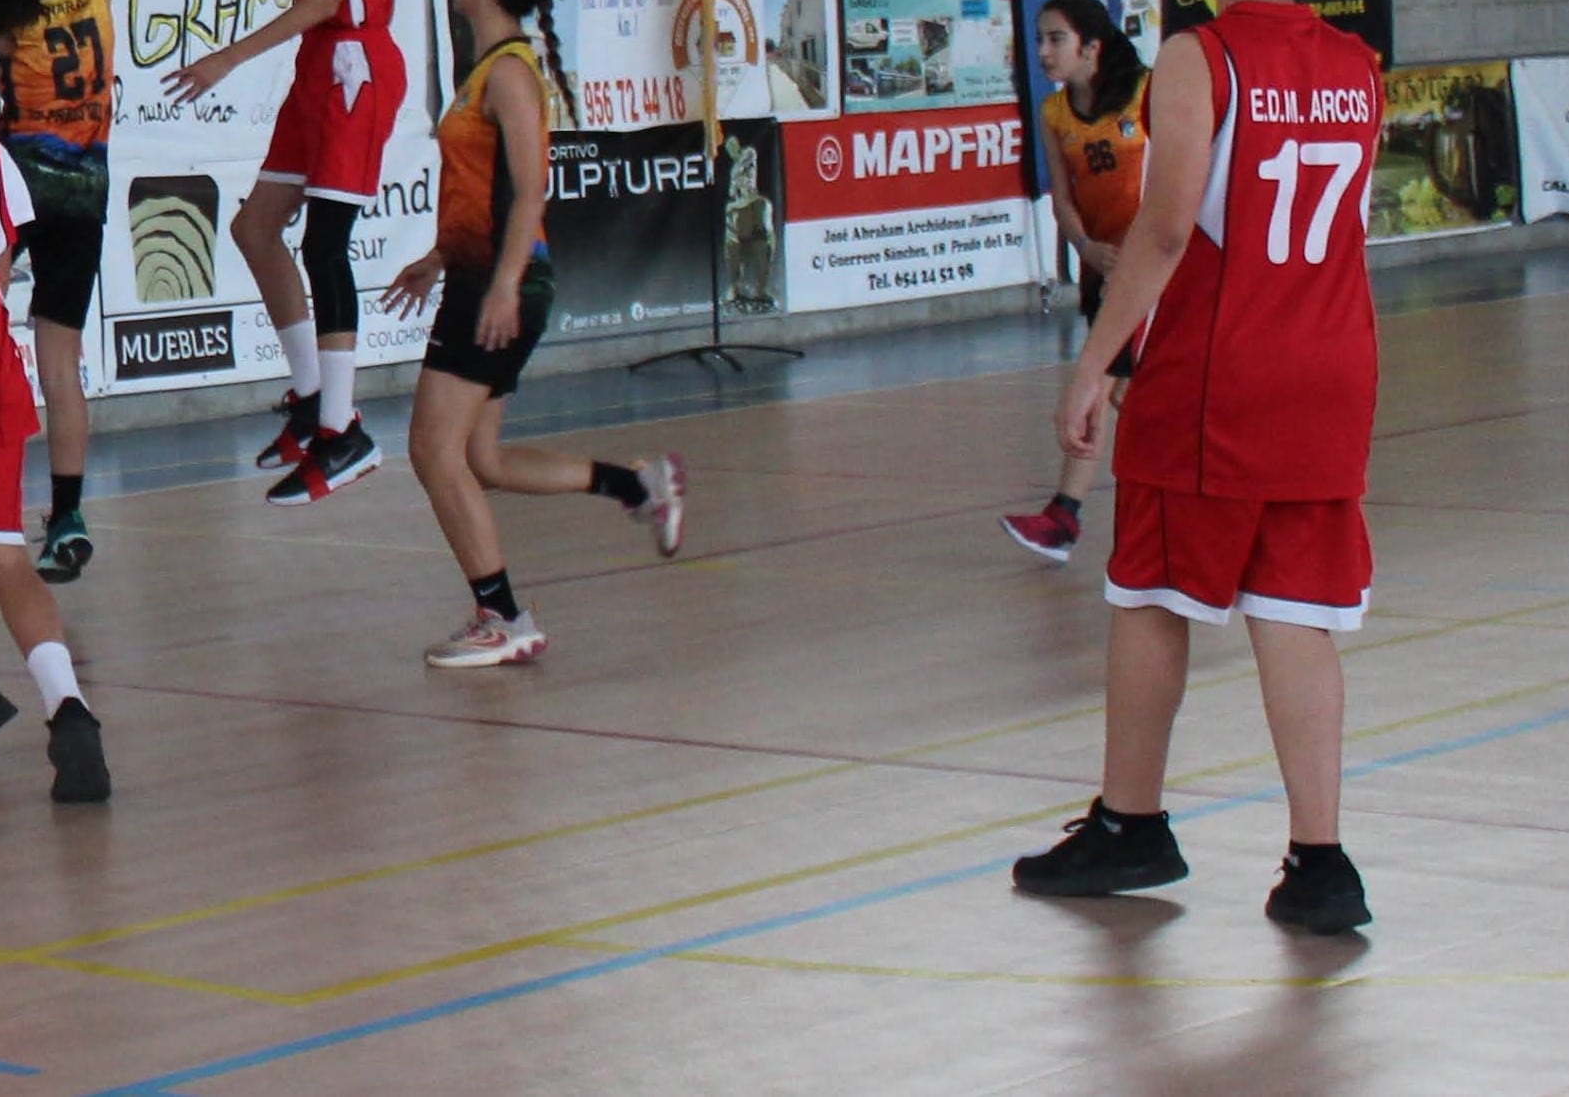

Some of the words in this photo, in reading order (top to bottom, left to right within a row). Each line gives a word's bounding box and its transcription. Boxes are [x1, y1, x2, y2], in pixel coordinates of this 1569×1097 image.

[44, 17, 105, 100] 27
[583, 81, 615, 126] 956
[616, 78, 640, 122] 72
[664, 75, 686, 119] 18
[1250, 88, 1303, 123] E.D.M.
[1310, 87, 1369, 123] ARCOS
[547, 143, 599, 161] ORTIVO
[852, 119, 1023, 179] MAPFRE
[1258, 138, 1363, 265] 17
[823, 228, 848, 244] José
[852, 223, 905, 241] Abraham
[828, 251, 881, 268] Guerrero
[951, 238, 982, 253] Prado
[983, 235, 1003, 249] del
[1004, 232, 1024, 249] Rey
[867, 273, 892, 291] Tel.
[940, 265, 955, 281] 52
[957, 262, 975, 279] 98
[121, 327, 229, 365] MUEBLES
